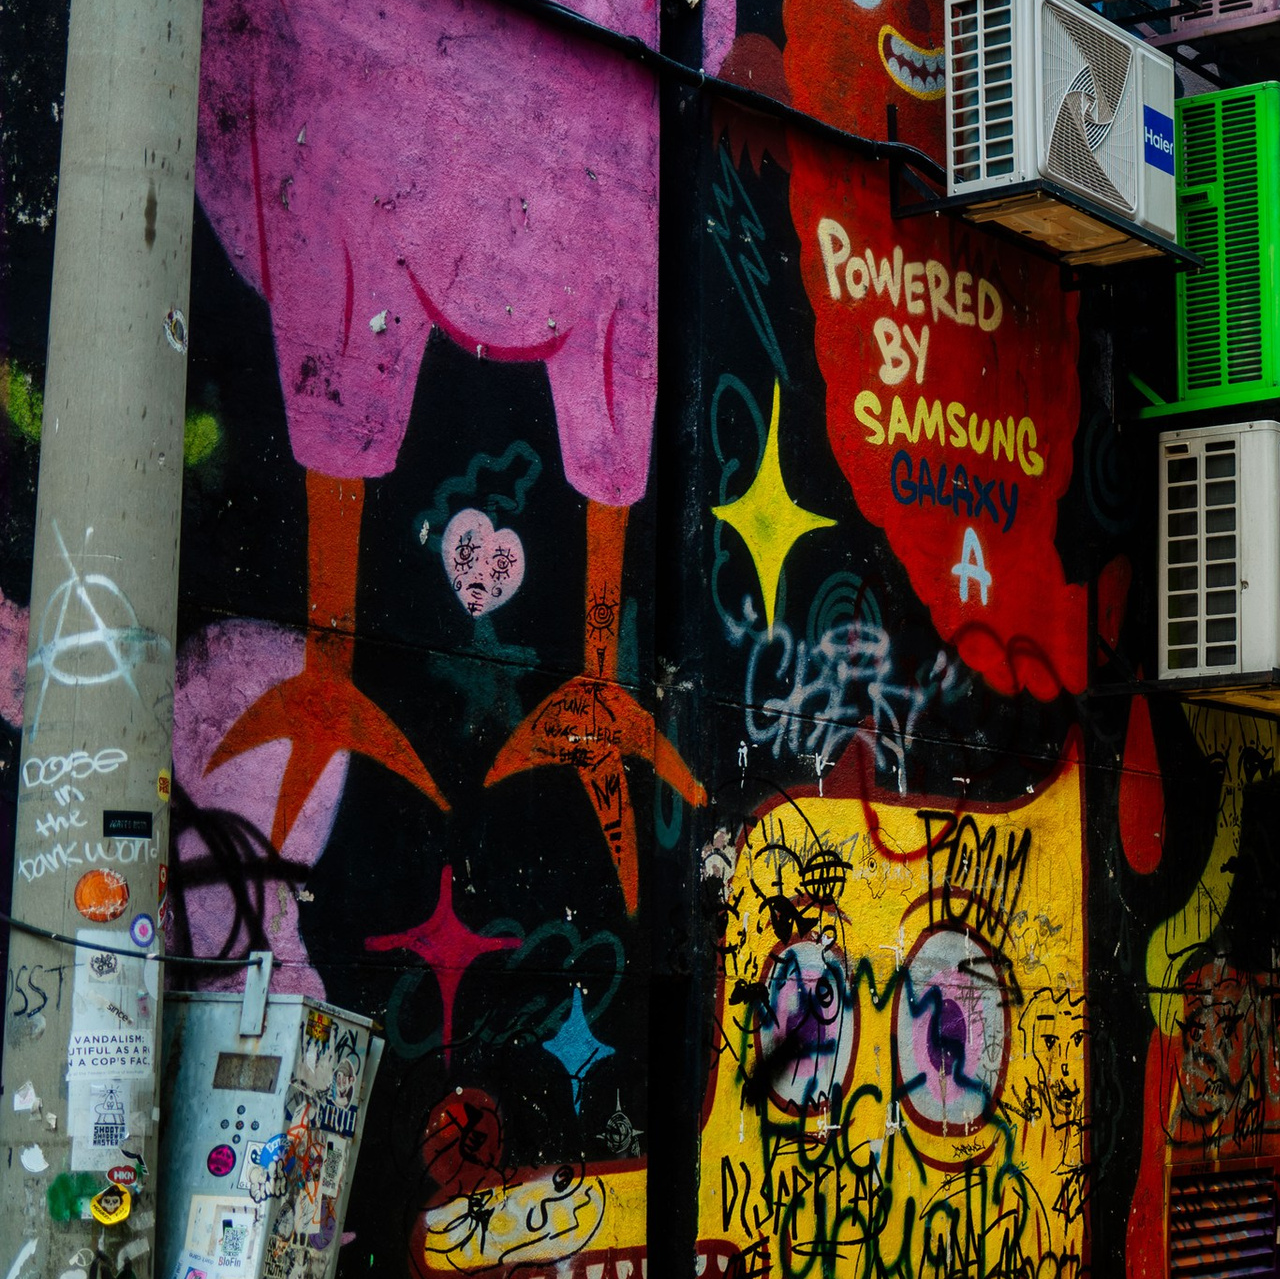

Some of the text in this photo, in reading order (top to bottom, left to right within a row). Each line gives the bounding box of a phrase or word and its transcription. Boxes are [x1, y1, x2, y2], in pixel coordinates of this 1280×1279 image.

[1144, 124, 1174, 157] Haier
[817, 218, 1002, 331] POWERED
[873, 317, 930, 386] BY
[854, 390, 1045, 476] SAMSUNG
[891, 449, 1019, 533] GALAXY
[952, 527, 992, 606] A
[74, 1035, 144, 1044] VANDALISM:
[78, 1058, 86, 1066] A
[91, 1057, 126, 1066] COP'S
[130, 1057, 150, 1066] FAC
[116, 1046, 129, 1054] AS
[133, 1046, 139, 1054] A
[142, 1046, 150, 1054] R
